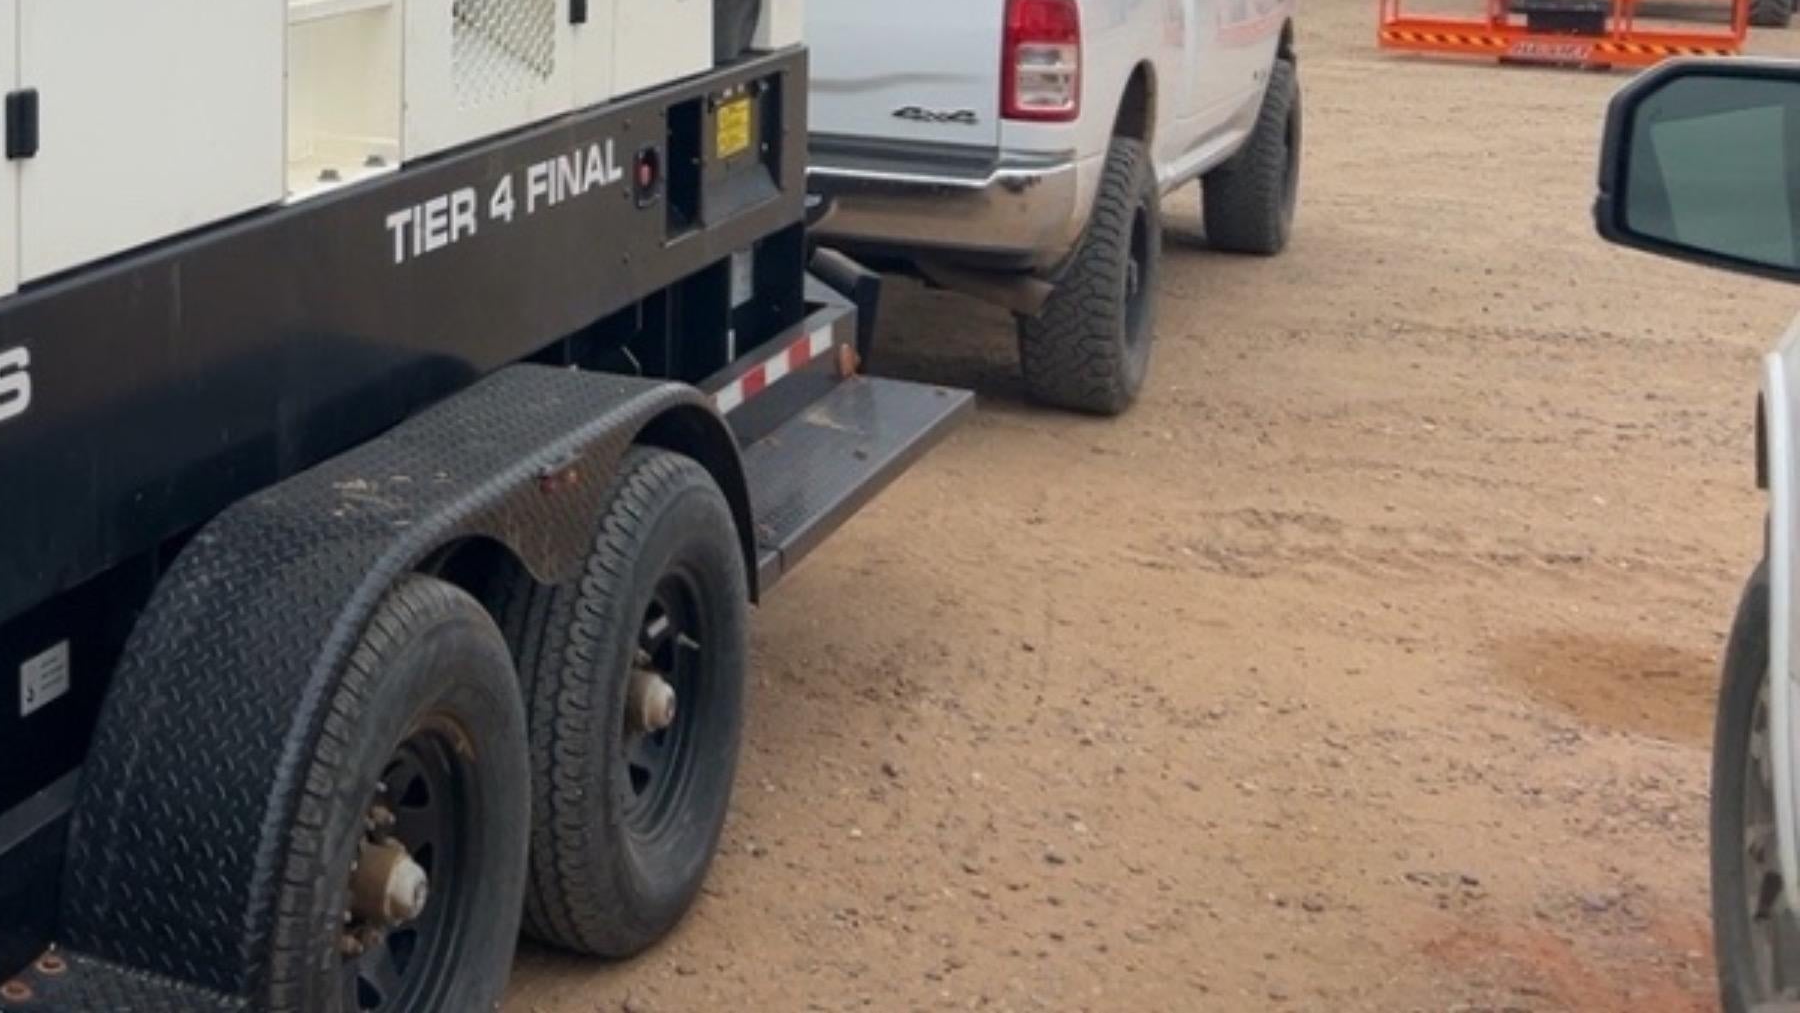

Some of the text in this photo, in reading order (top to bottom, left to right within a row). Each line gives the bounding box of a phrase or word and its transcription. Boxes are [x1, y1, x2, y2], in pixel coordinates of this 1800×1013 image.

[386, 139, 623, 264] TIER 4 FINAL
